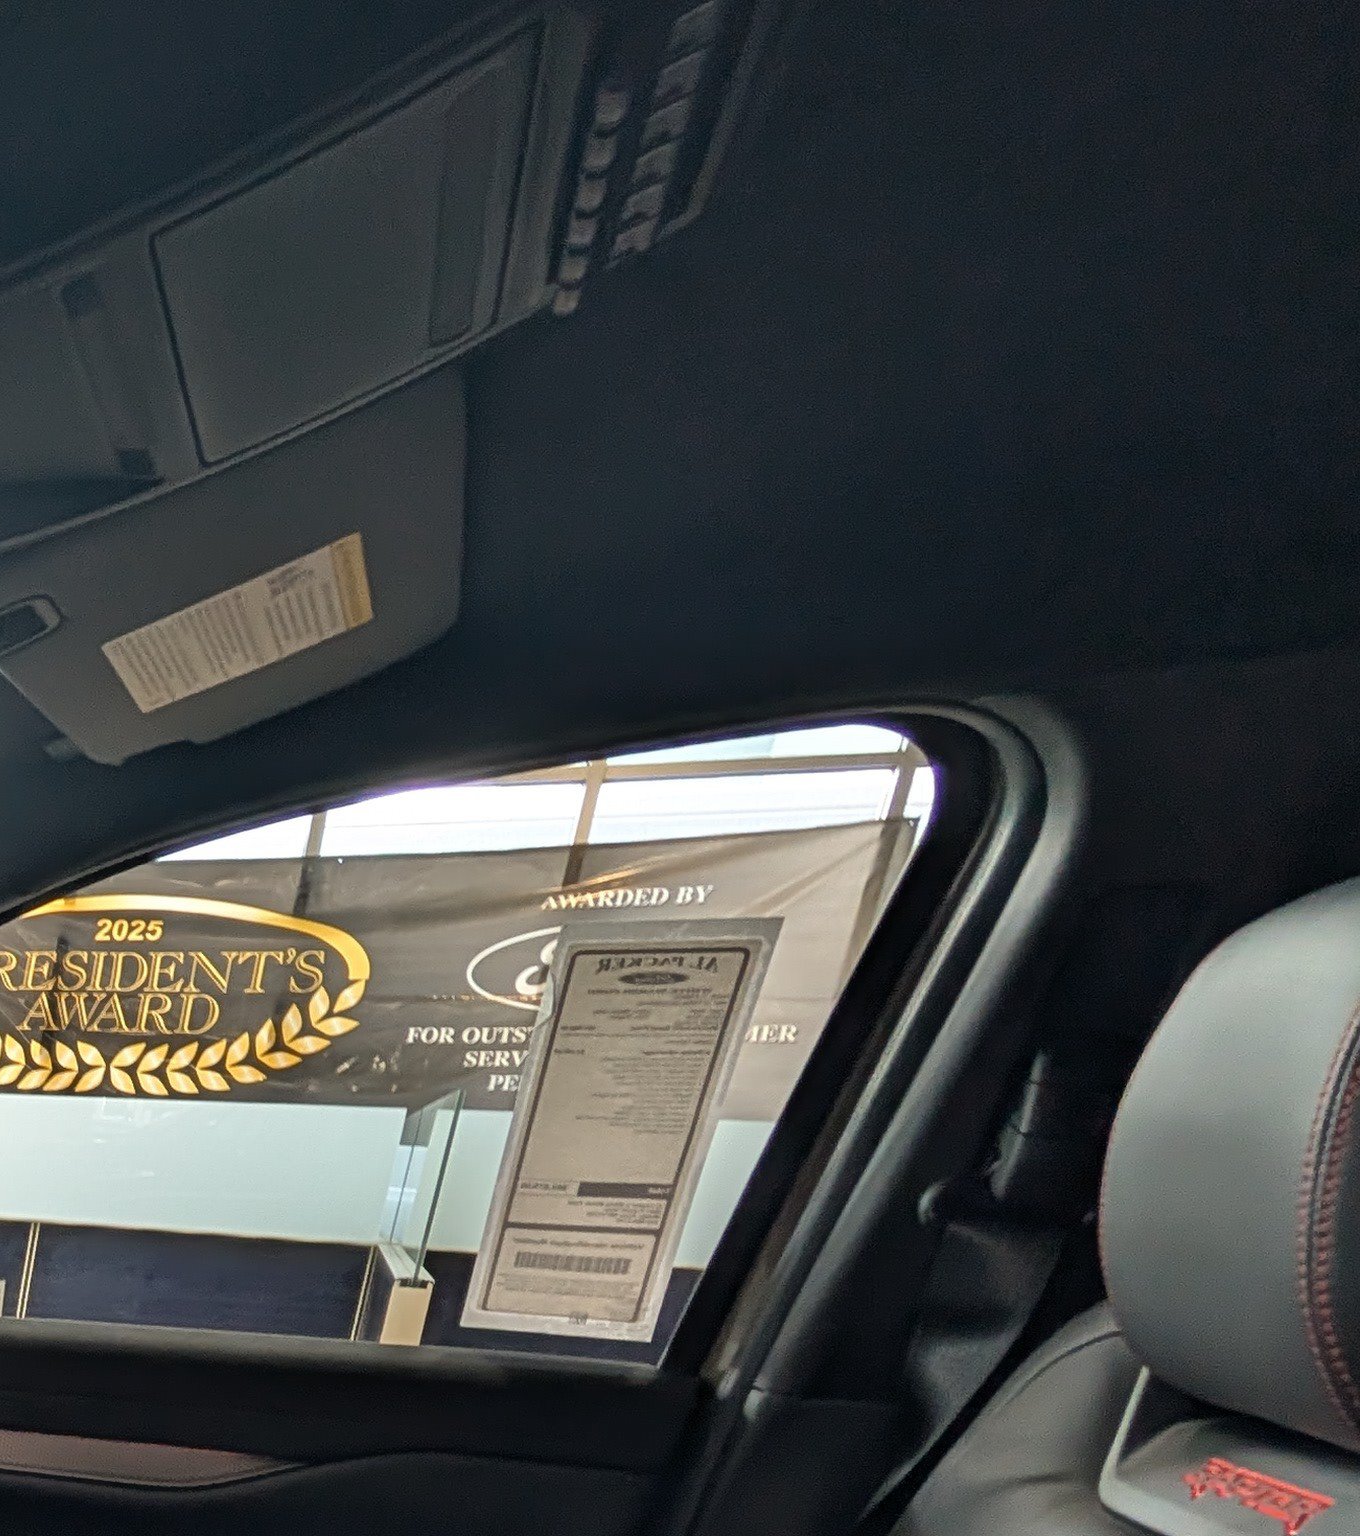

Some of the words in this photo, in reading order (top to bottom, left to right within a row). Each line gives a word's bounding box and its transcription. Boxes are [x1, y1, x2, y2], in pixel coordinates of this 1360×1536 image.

[541, 886, 670, 911] AWARDED
[675, 884, 714, 905] BY
[94, 918, 164, 942] 2025
[17, 991, 221, 1035] AWARD
[406, 1026, 456, 1044] FOR
[462, 1026, 534, 1044] OUTS
